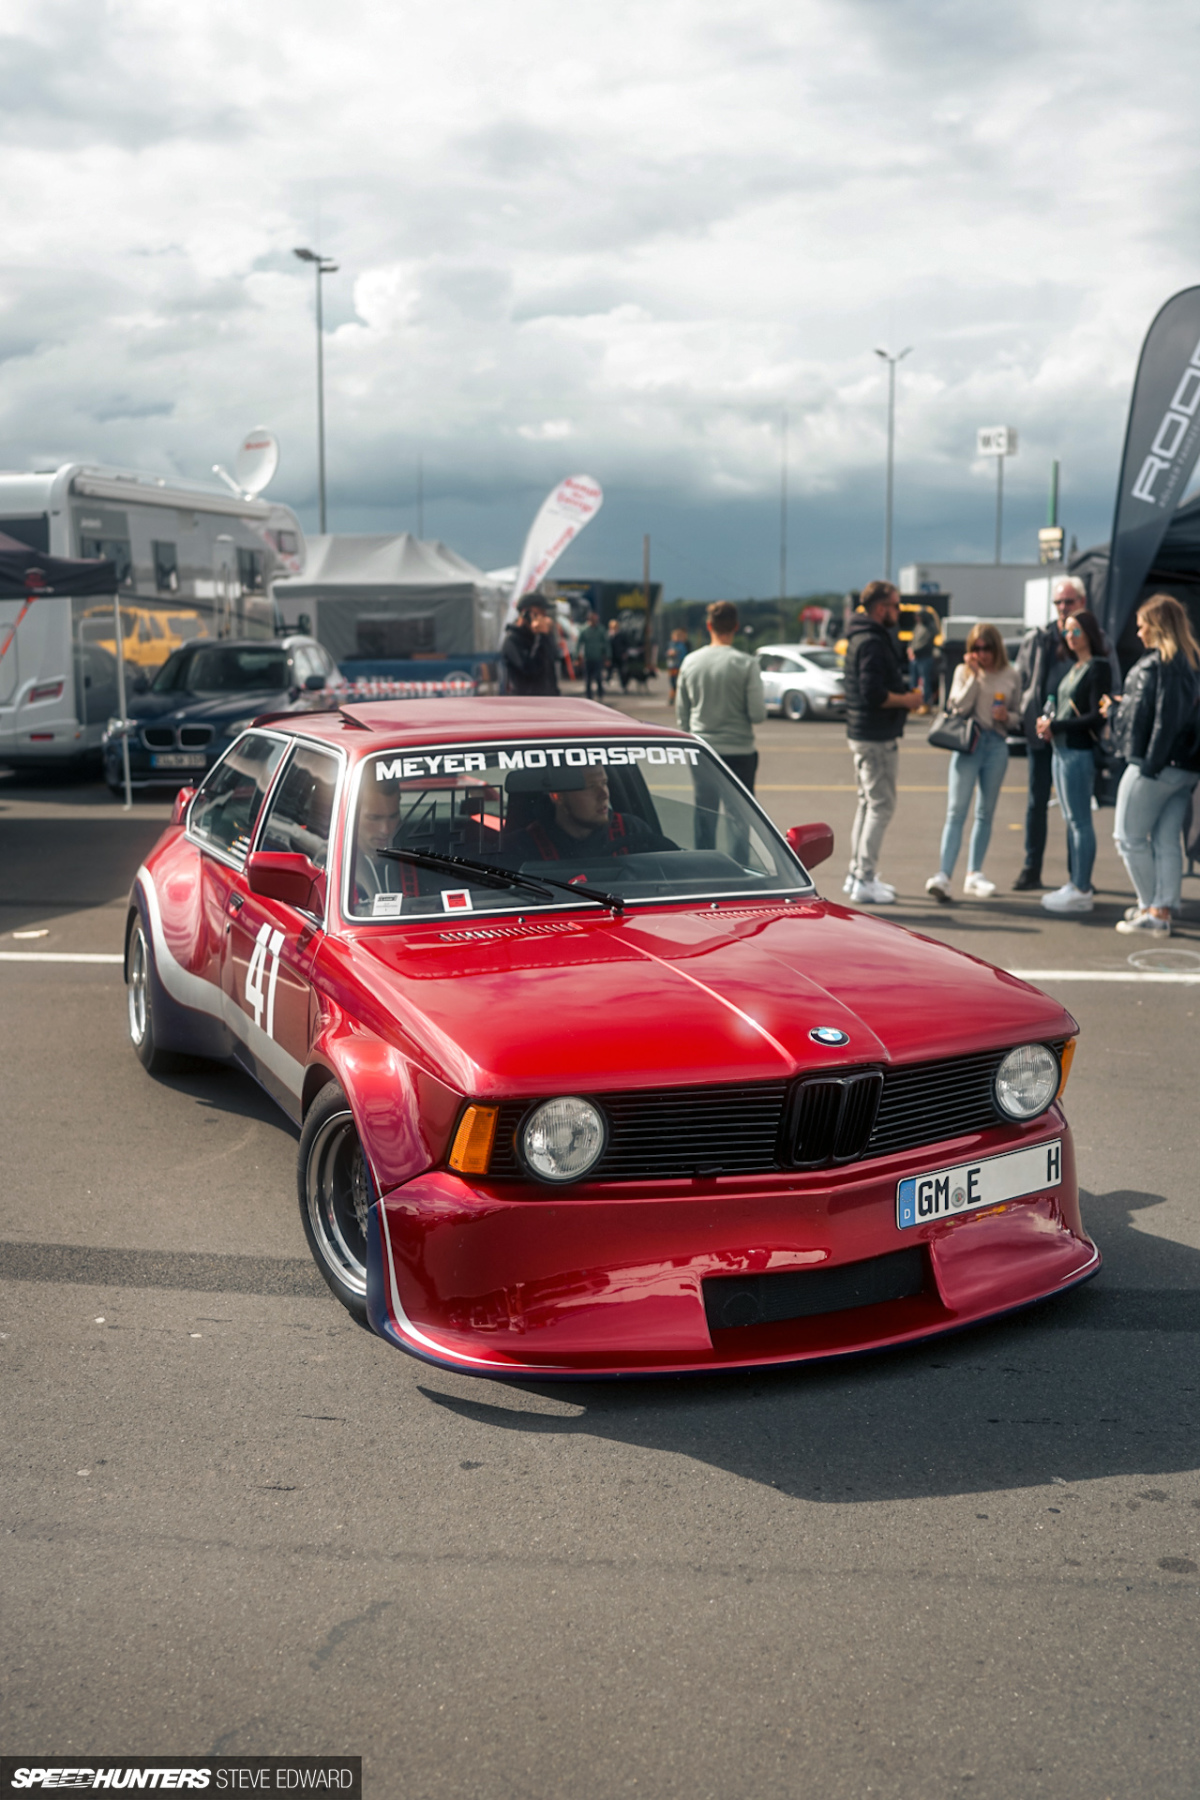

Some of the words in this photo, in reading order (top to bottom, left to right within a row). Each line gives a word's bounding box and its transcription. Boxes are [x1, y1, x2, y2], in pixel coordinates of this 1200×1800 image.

[980, 432, 1004, 448] WC
[376, 753, 486, 781] MEYER
[498, 747, 700, 769] MOTORSPORT
[245, 922, 286, 1039] 41
[918, 1176, 949, 1216] GM
[967, 1167, 981, 1204] E
[1047, 1146, 1059, 1182] H
[904, 1208, 911, 1219] D
